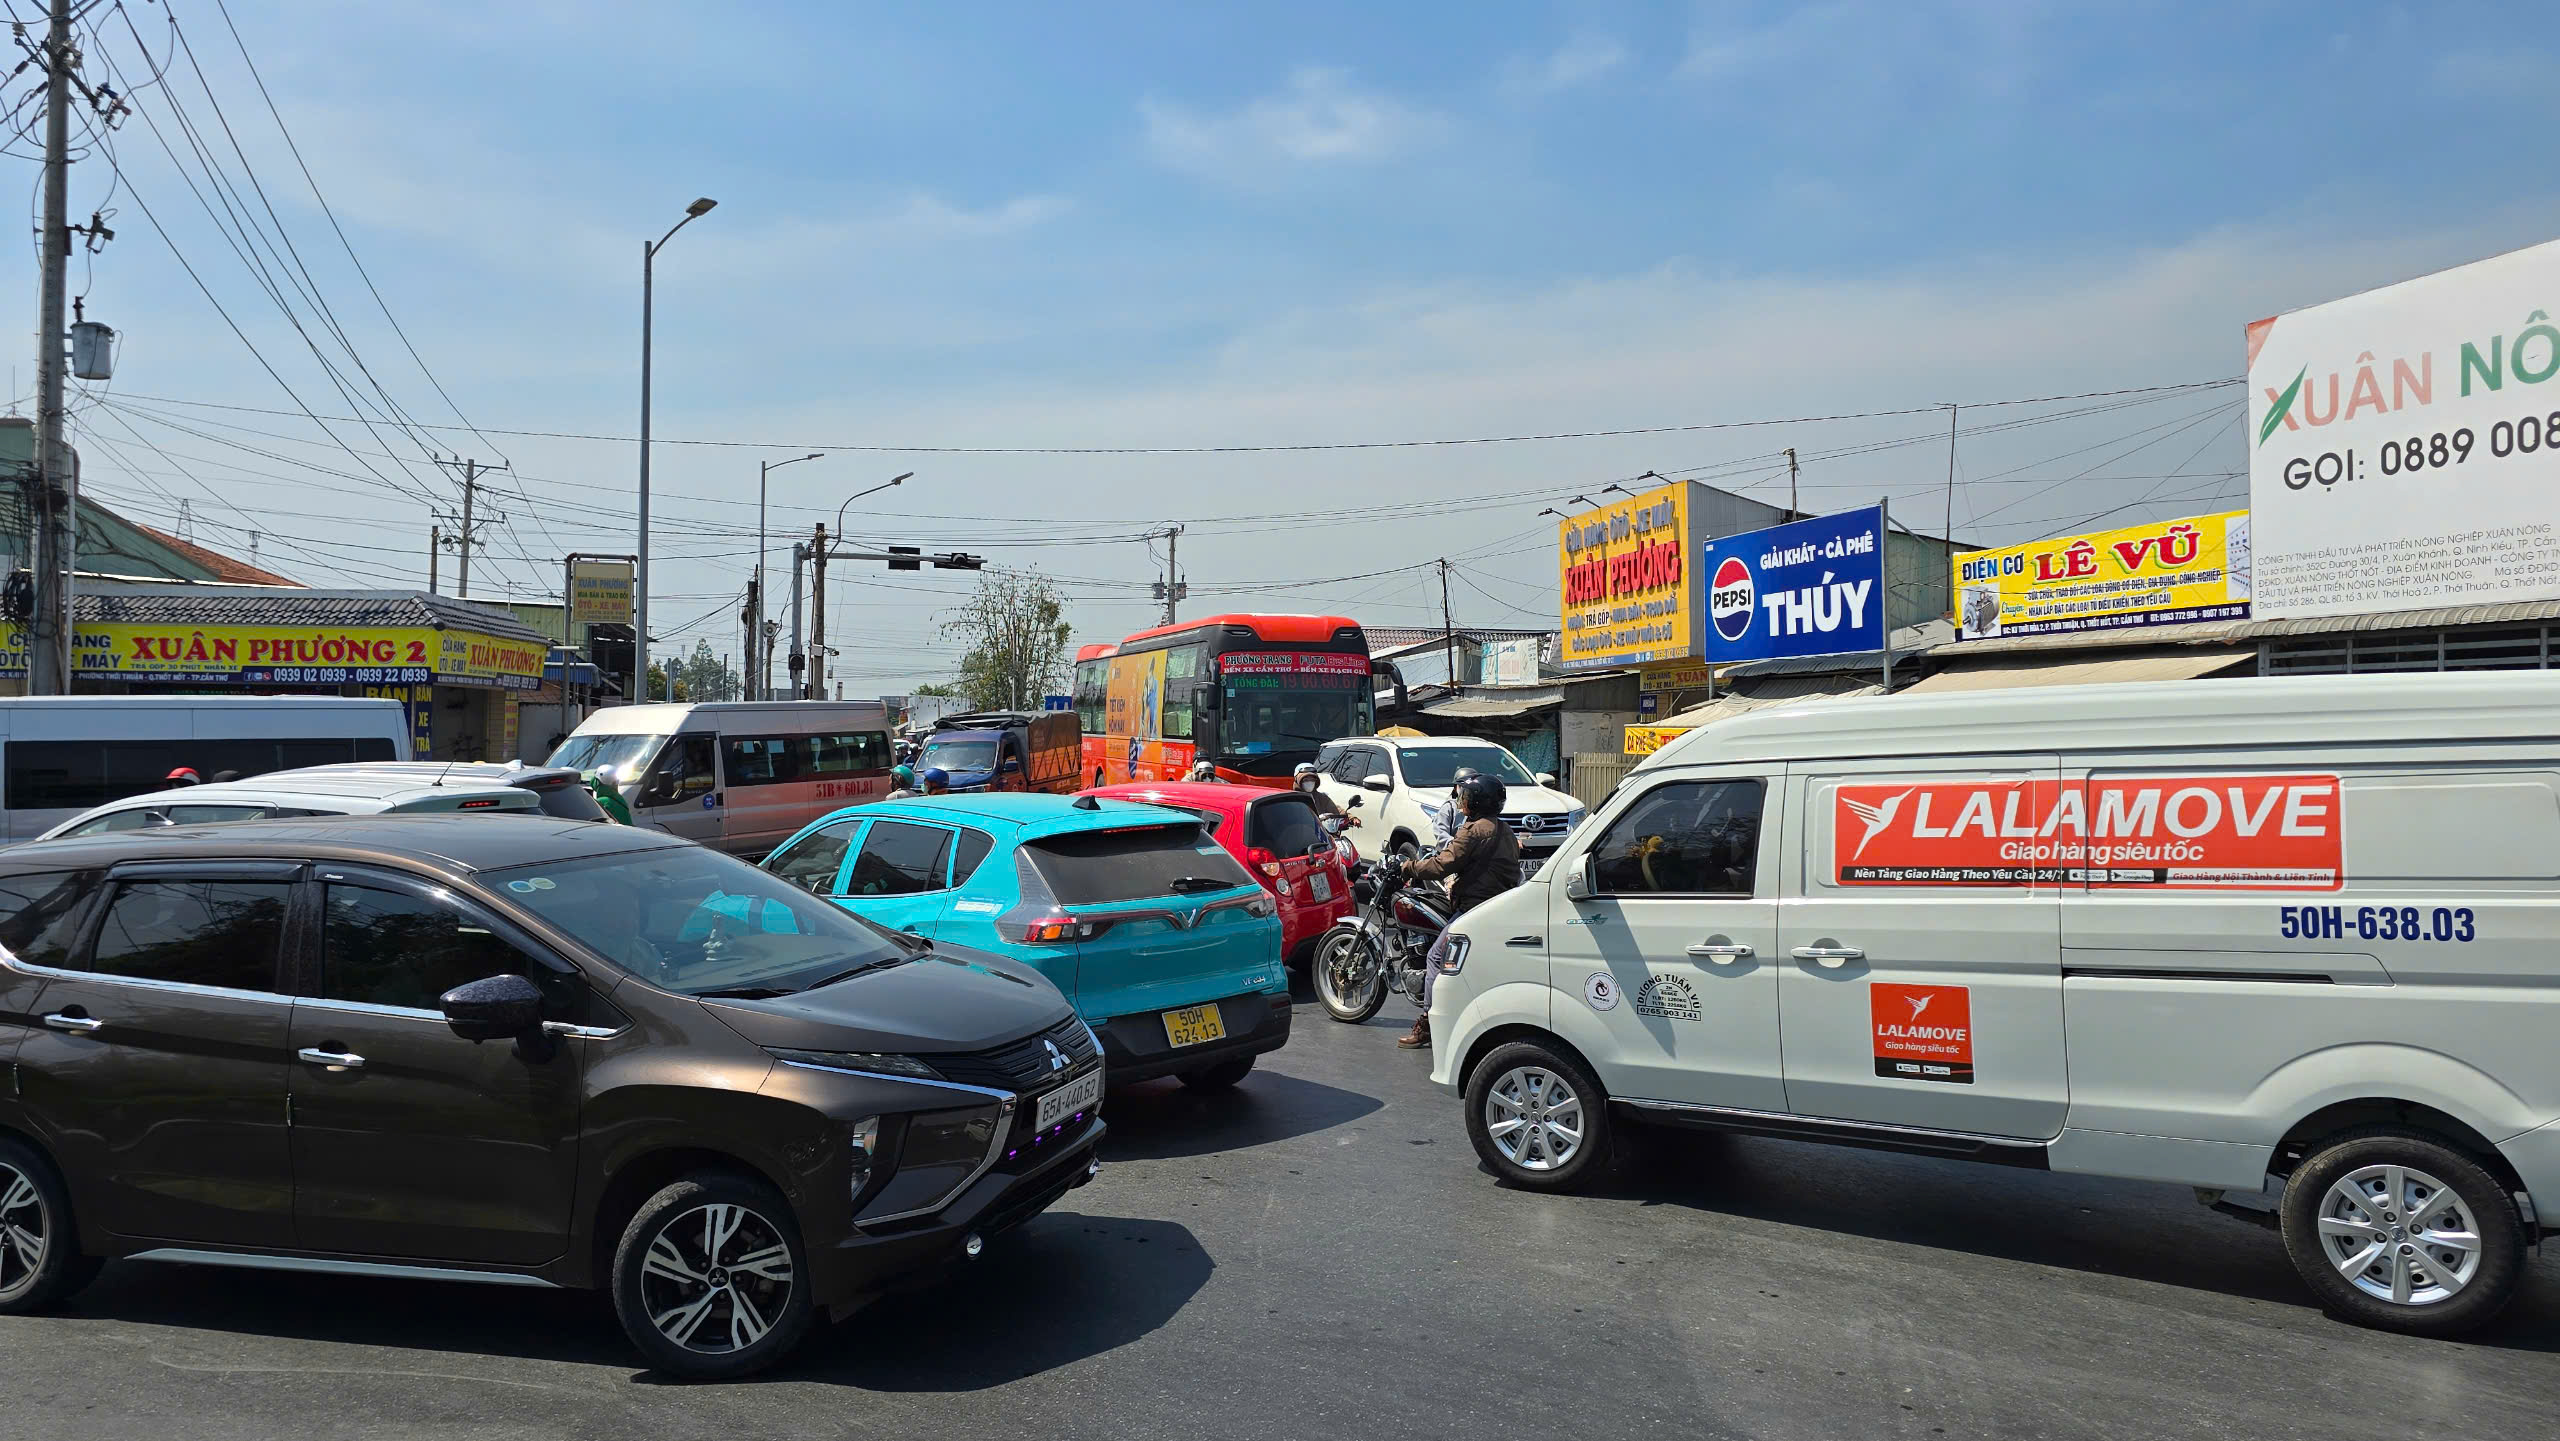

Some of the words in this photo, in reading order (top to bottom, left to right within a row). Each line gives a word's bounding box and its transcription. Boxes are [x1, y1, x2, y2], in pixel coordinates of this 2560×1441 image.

[2259, 351, 2432, 448] XUÂN
[2284, 449, 2364, 492] GỌI:
[2381, 428, 2474, 475] 0889
[1760, 546, 1782, 570] GIẢI
[1785, 542, 1816, 566] KHÁT
[1825, 536, 1844, 558] CÀ
[1846, 530, 1874, 554] PHÊ
[1962, 556, 1998, 582] ĐIỆN
[2003, 553, 2024, 575] CƠ
[2034, 540, 2098, 582] LÊ
[2112, 525, 2200, 570] VŨ
[1565, 552, 1607, 604] XUÂN
[1609, 538, 1680, 595] PHƯƠNG
[2306, 561, 2327, 571] 352C
[1713, 588, 1751, 609] PEPSI
[1762, 571, 1872, 637] THÚY
[1586, 610, 1597, 627] TRẢ
[1598, 609, 1609, 625] GÓP
[130, 630, 239, 662] XUÂN
[248, 634, 396, 663] PHƯƠNG
[405, 641, 427, 663] 2
[82, 651, 122, 668] MÁY
[470, 640, 498, 667] XUÂN
[499, 647, 536, 673] PHƯƠNG
[1225, 652, 1261, 665] PHƯƠNG
[1262, 655, 1292, 664] TRANG
[1300, 655, 1327, 665] FUTA
[1328, 656, 1343, 666] Bus
[1344, 657, 1366, 667] Lines
[274, 668, 300, 682] 0939
[304, 668, 317, 682] 02
[320, 668, 347, 682] 0939
[356, 669, 382, 682] 0939
[385, 669, 398, 682] 22
[401, 669, 428, 682] 0939
[1224, 665, 1241, 674] BẾN
[1300, 665, 1317, 673] BẾN
[1330, 667, 1352, 675] RẠCH
[1234, 674, 1257, 688] TỔNG
[1260, 676, 1279, 687] ĐÀI:
[415, 684, 432, 702] BÁN
[418, 711, 429, 727] XE
[415, 732, 430, 752] TRẢ
[1912, 786, 2332, 838] LALAMOVE
[2000, 841, 2048, 860] Giao
[2051, 841, 2110, 865] hàng
[2112, 842, 2161, 861] siêu
[2163, 839, 2204, 861] tốc
[1854, 868, 1875, 878] Nền
[1878, 867, 1903, 881] Tảng
[1905, 868, 1929, 879] Giao
[1931, 867, 1960, 881] Hàng
[1962, 869, 1990, 879] Theo
[1992, 868, 2012, 879] Yêu
[2014, 868, 2036, 880] Cầu
[2038, 869, 2064, 881] 24/7
[2173, 872, 2194, 881] Giao
[2196, 872, 2221, 882] Hàng
[2223, 873, 2240, 883] Nội
[2242, 872, 2272, 881] Thành
[2274, 873, 2282, 881] &
[2281, 906, 2475, 942] 50H-638.03
[1179, 1009, 1205, 1027] 50H
[1640, 1007, 1661, 1015] 0765
[1663, 1009, 1679, 1017] 003
[1682, 1011, 1698, 1019] 141
[1877, 1023, 1967, 1041] LALAMOVE
[1885, 1041, 1904, 1050] Giao
[1905, 1042, 1926, 1053] hàng
[1928, 1043, 1945, 1052] siêu
[1946, 1044, 1960, 1054] tốc
[1042, 1078, 1096, 1122] 65A-440.62
